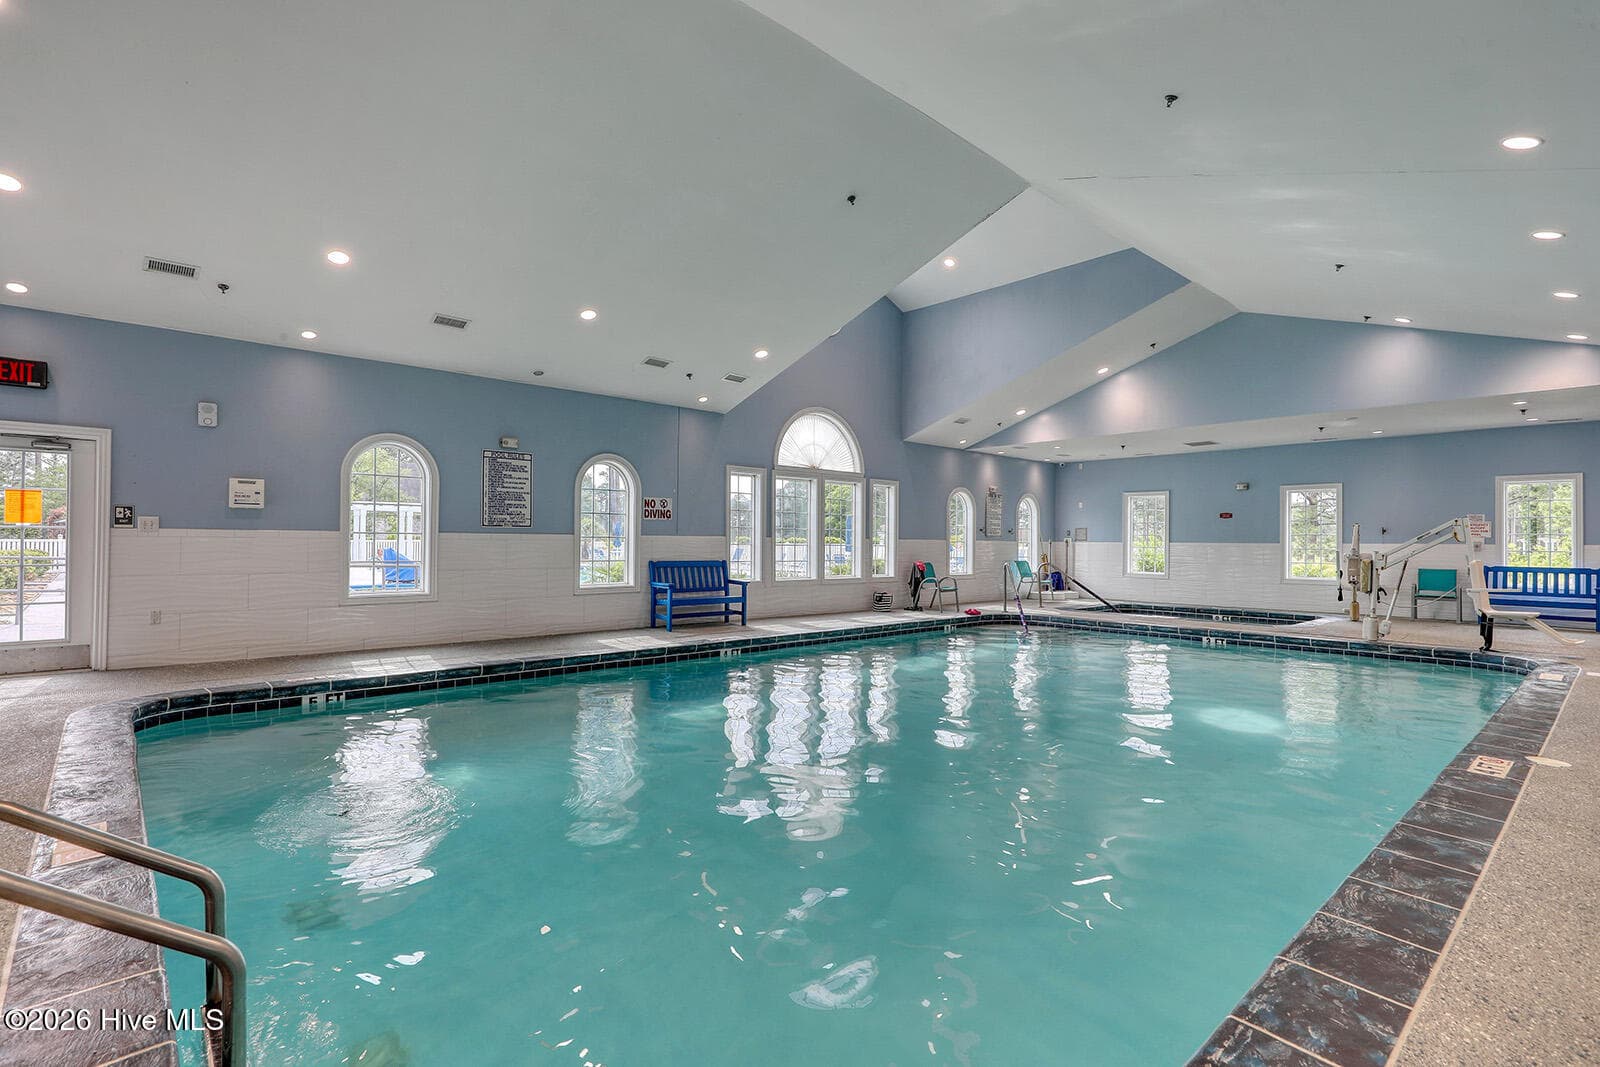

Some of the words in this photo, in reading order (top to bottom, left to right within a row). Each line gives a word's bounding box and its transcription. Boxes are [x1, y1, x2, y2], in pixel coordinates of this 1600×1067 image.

[0, 359, 35, 383] EXIT
[644, 499, 656, 508] NO
[644, 509, 671, 519] DIVING
